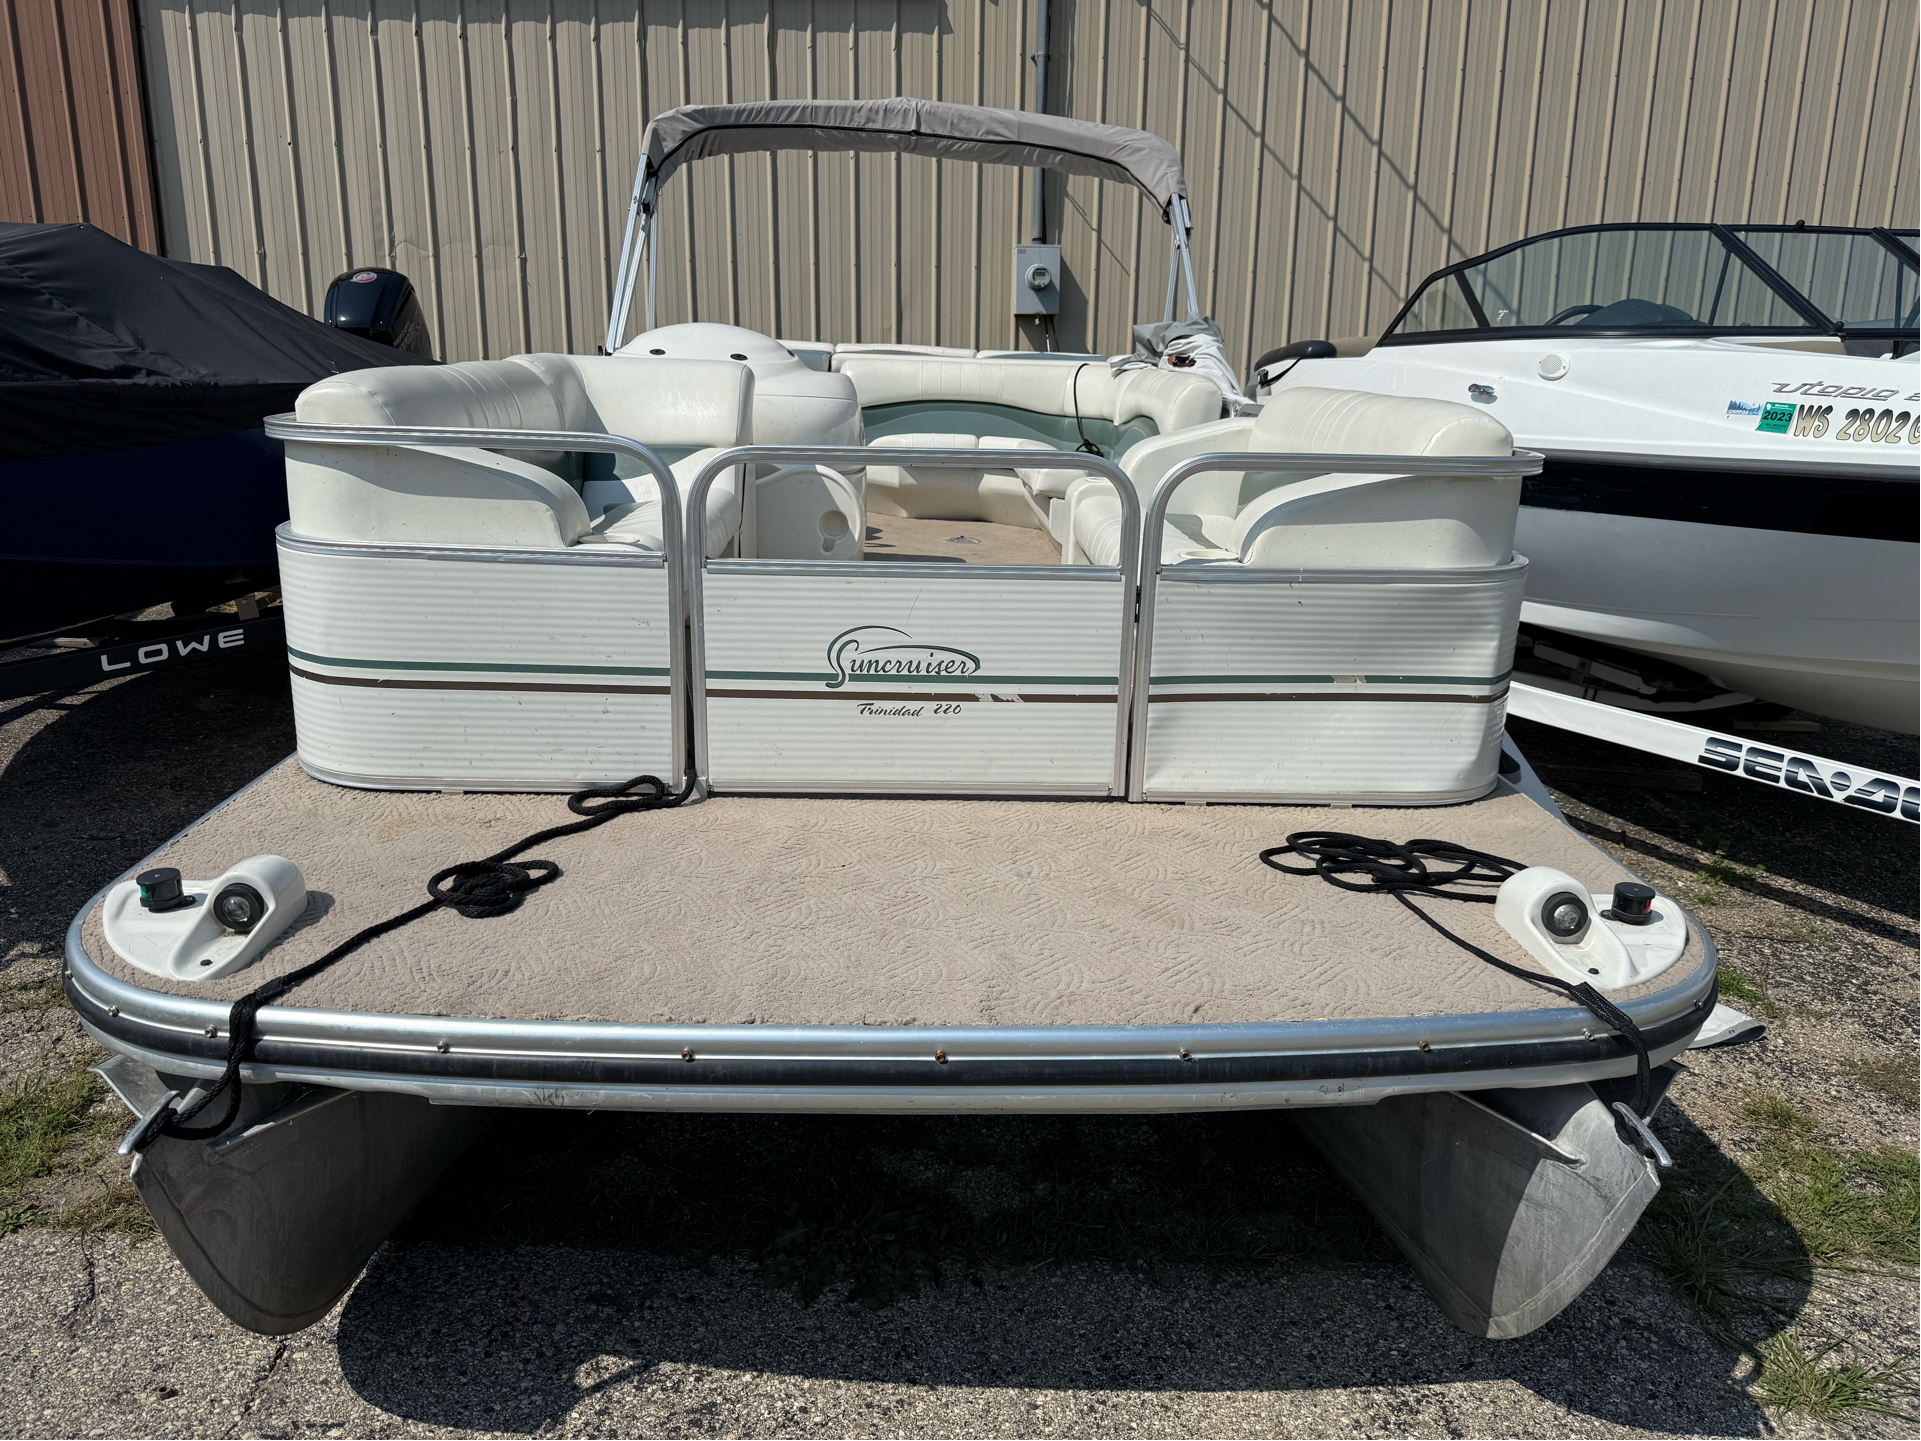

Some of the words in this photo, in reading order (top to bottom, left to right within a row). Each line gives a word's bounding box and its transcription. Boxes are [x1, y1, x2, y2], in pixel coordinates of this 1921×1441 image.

[1762, 410, 1794, 423] 2023
[1793, 403, 1834, 439] WS
[1836, 407, 1911, 444] 2802
[100, 628, 245, 672] LOWE
[825, 637, 973, 689] Suncruiser
[856, 702, 925, 718] Trinidad
[933, 703, 962, 715] 220
